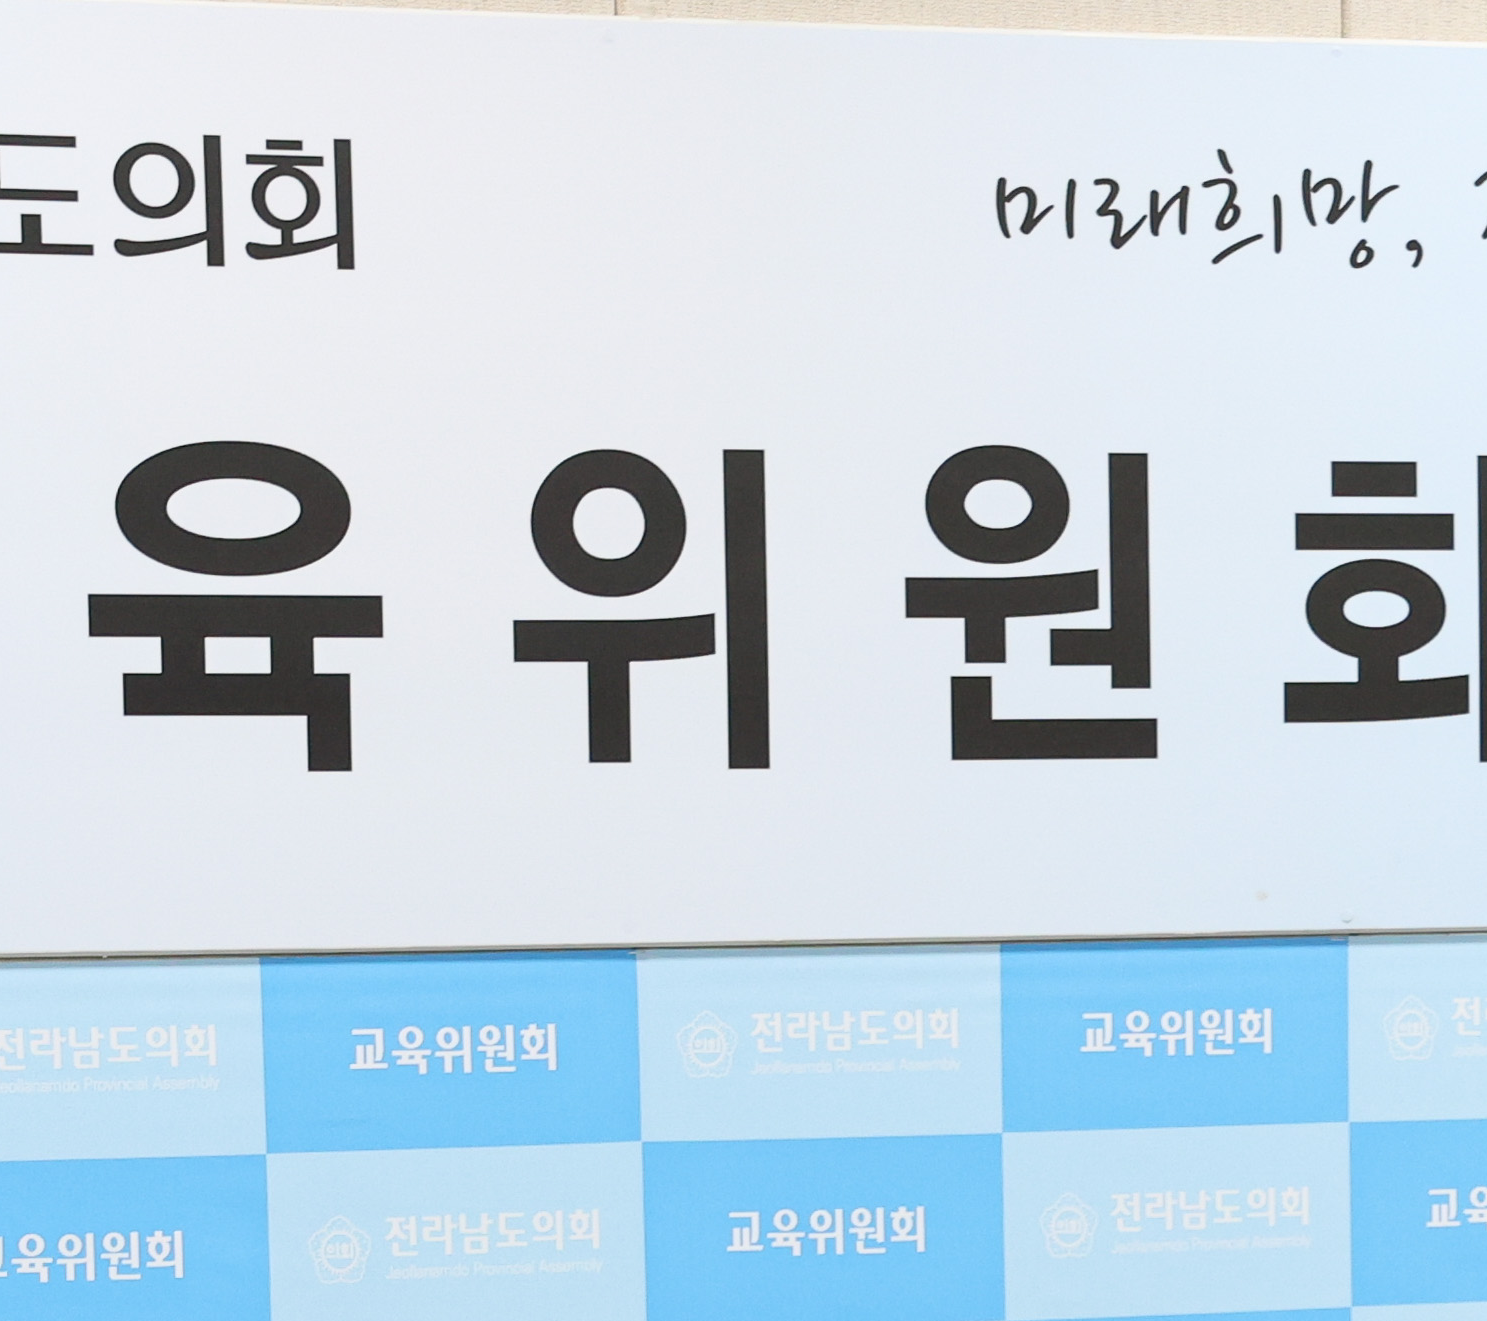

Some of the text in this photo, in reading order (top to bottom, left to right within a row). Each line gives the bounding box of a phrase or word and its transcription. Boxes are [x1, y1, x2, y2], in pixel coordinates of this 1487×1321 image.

[997, 149, 1424, 270] 미래희망,
[351, 1025, 557, 1075] 교육위원회
[753, 1011, 959, 1053] 전라남도의회
[1082, 1010, 1272, 1057] 교육위원회
[728, 1208, 926, 1257] 교육위원회
[1114, 1188, 1309, 1232] 전라남도의회
[387, 1211, 600, 1257] 전라남도의회
